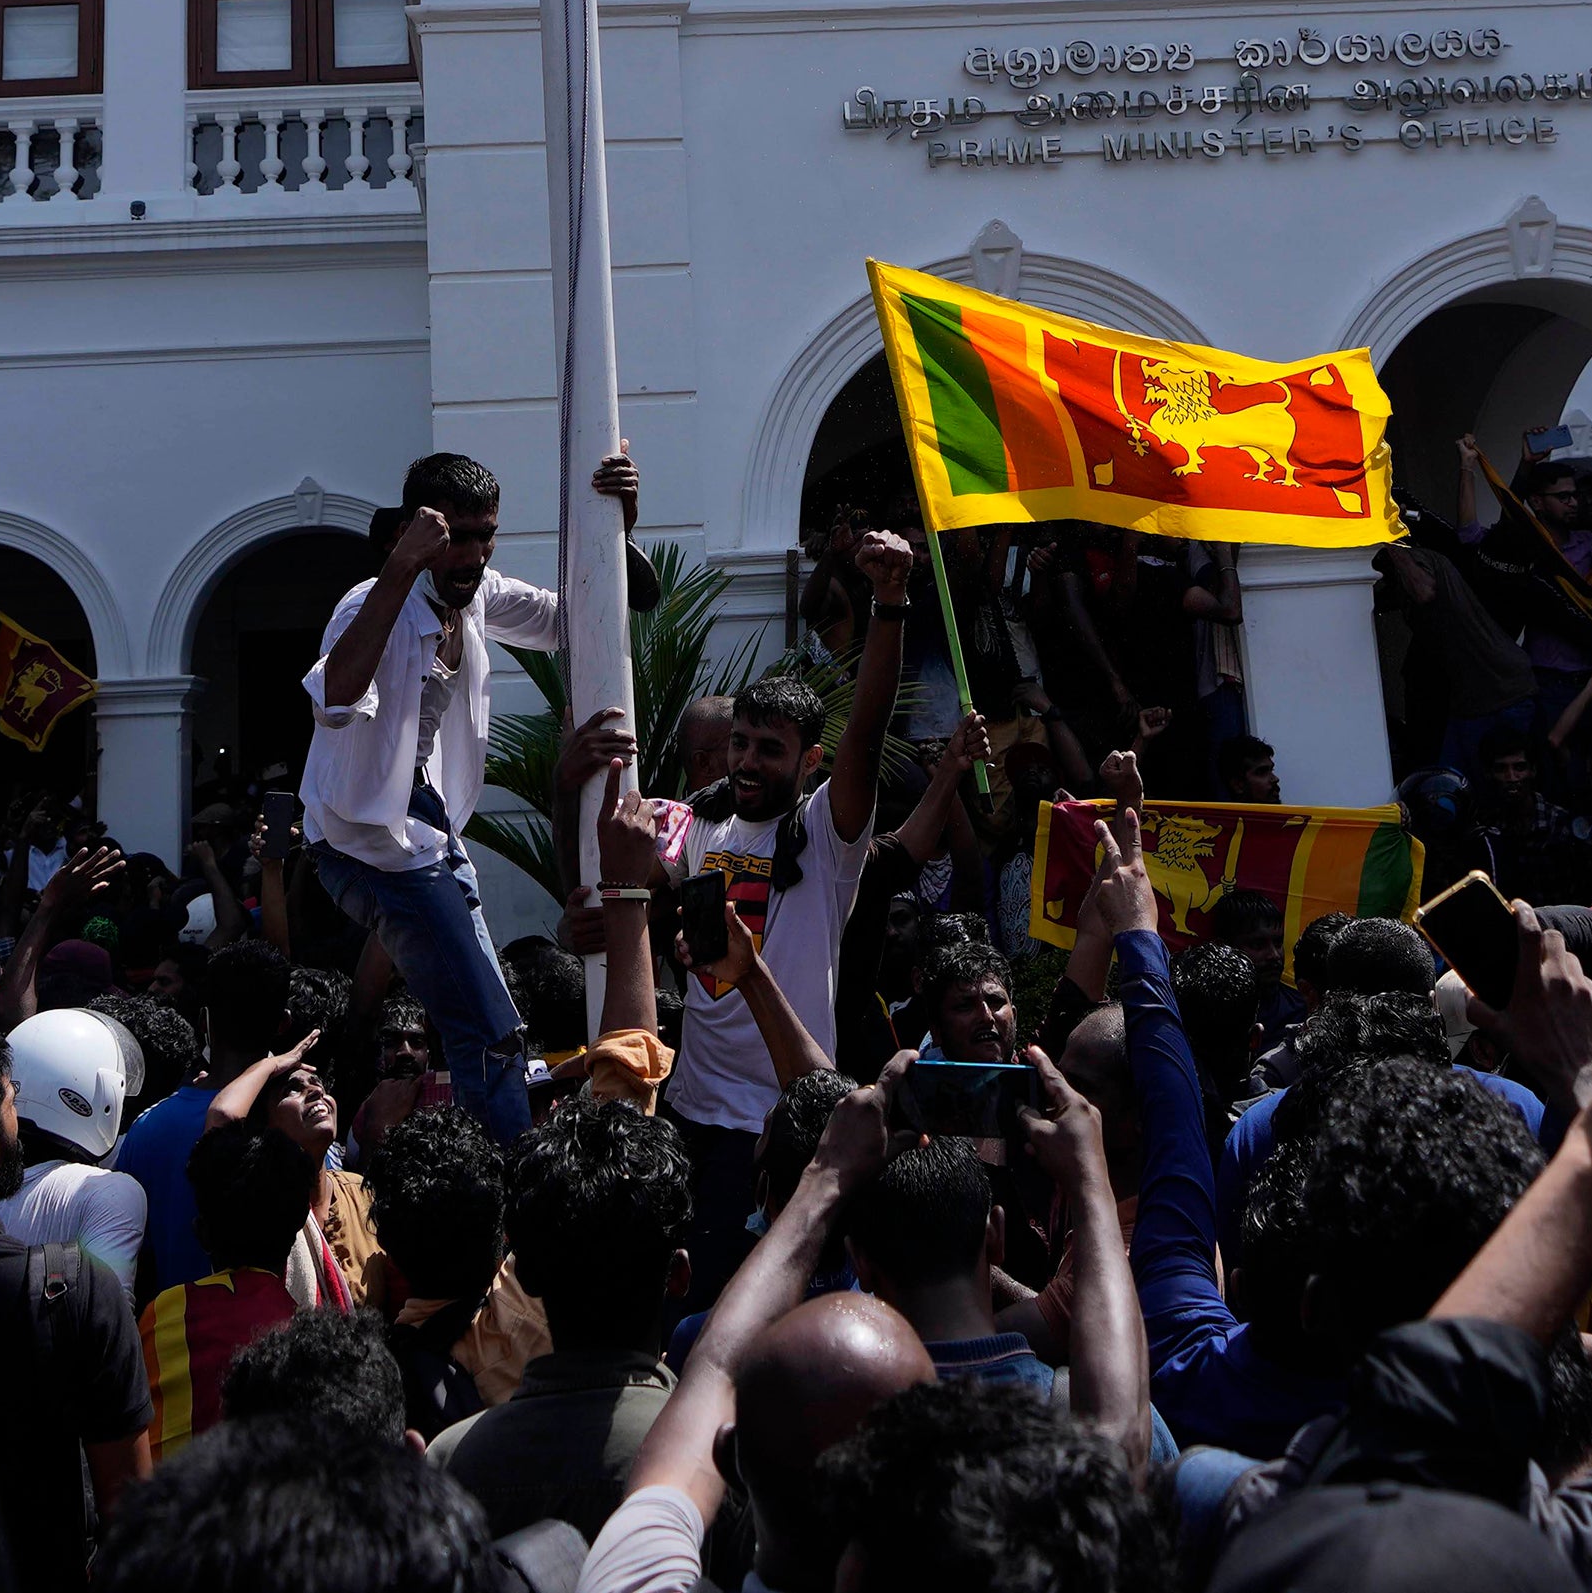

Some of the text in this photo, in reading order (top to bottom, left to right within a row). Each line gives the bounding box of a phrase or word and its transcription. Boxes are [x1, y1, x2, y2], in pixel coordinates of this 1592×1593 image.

[928, 134, 1063, 168] PRIME
[1398, 115, 1557, 149] OFFICE
[703, 854, 770, 873] PRSHE
